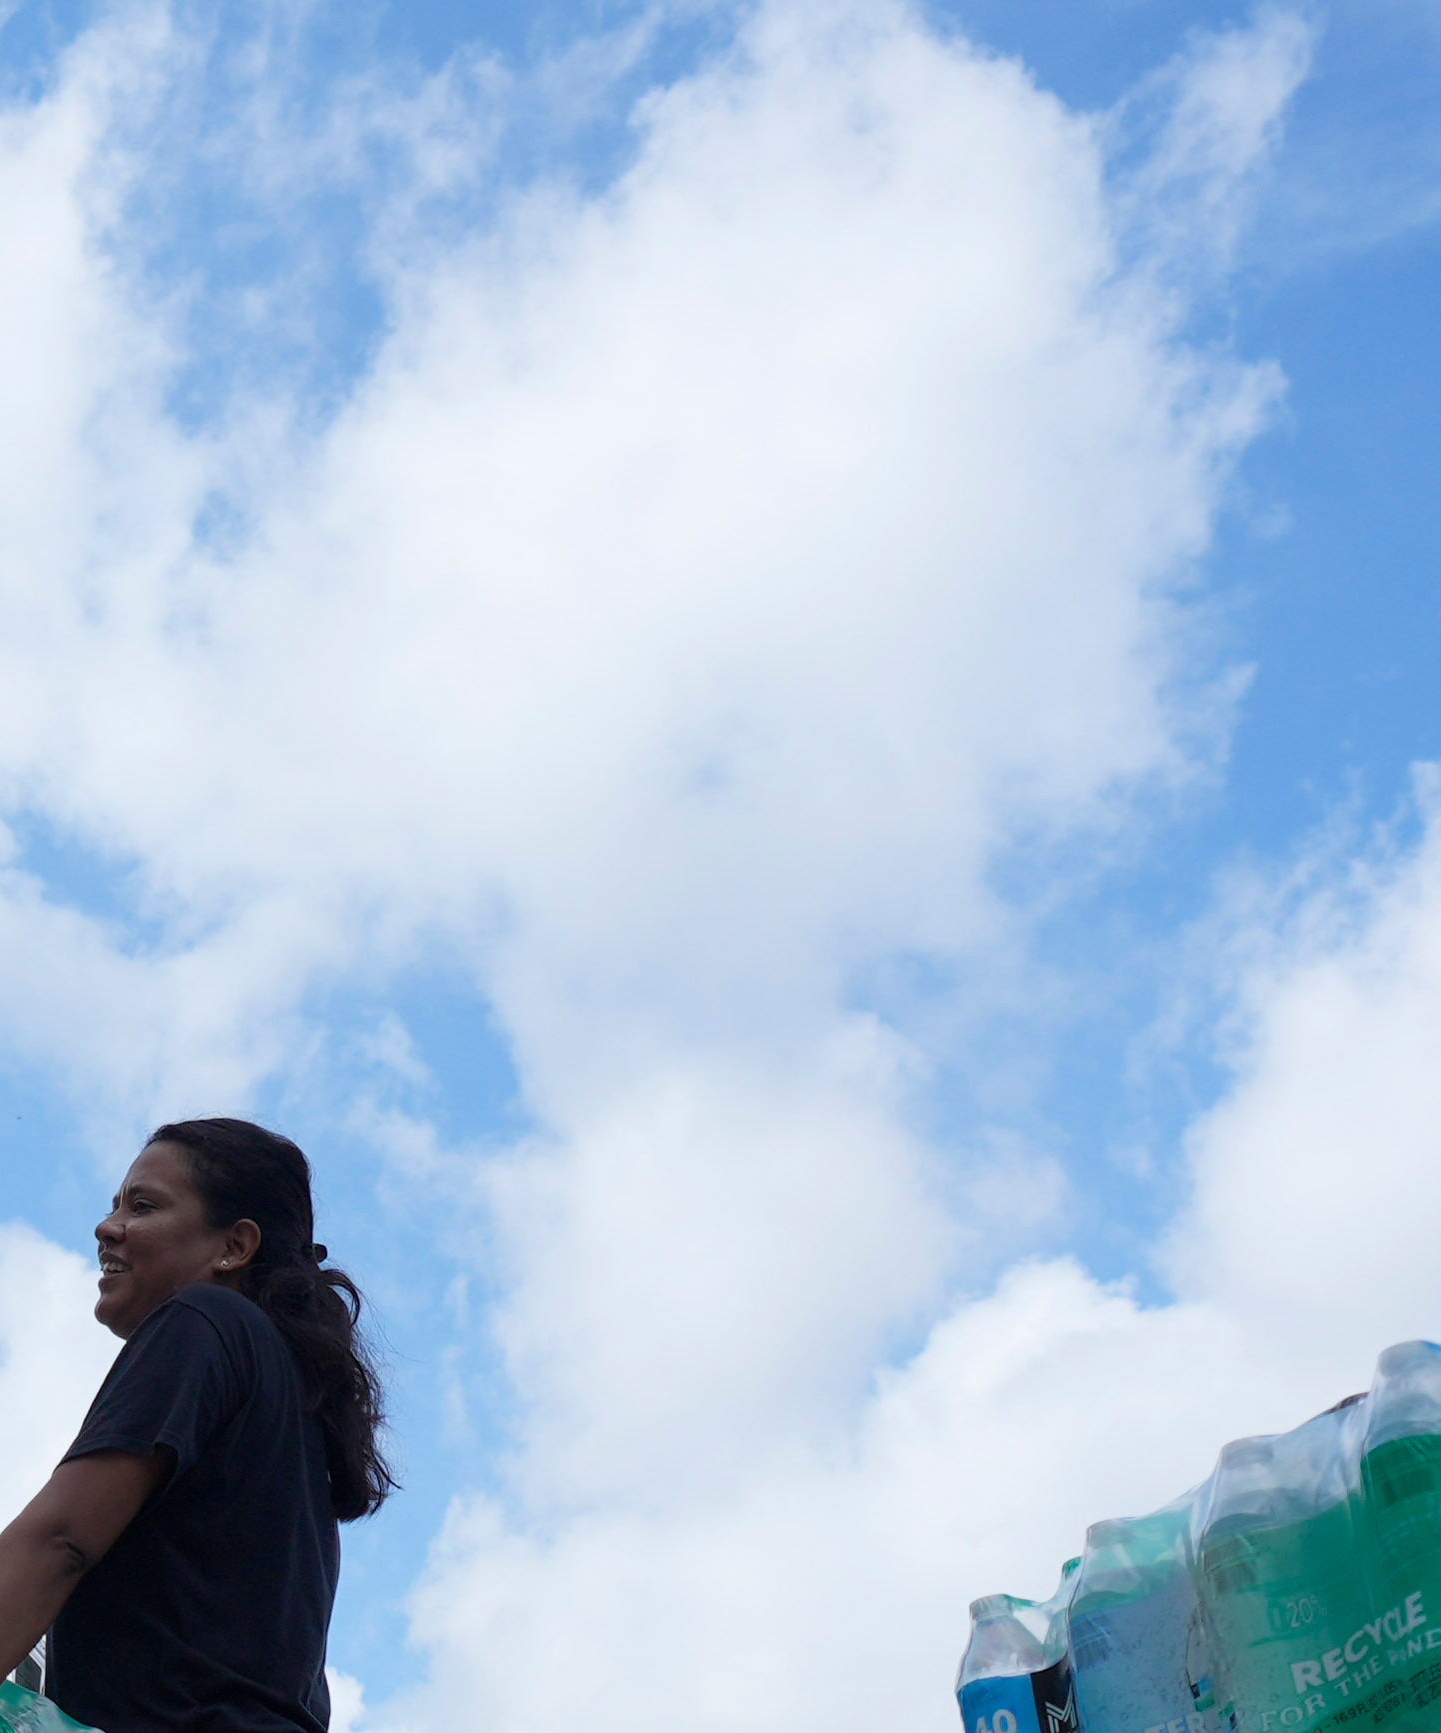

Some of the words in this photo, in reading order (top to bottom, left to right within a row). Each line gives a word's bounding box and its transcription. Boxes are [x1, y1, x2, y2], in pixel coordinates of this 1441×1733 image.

[1291, 1590, 1427, 1694] RECYCLE
[1261, 1692, 1327, 1733] FOR
[1334, 1655, 1383, 1697] THE
